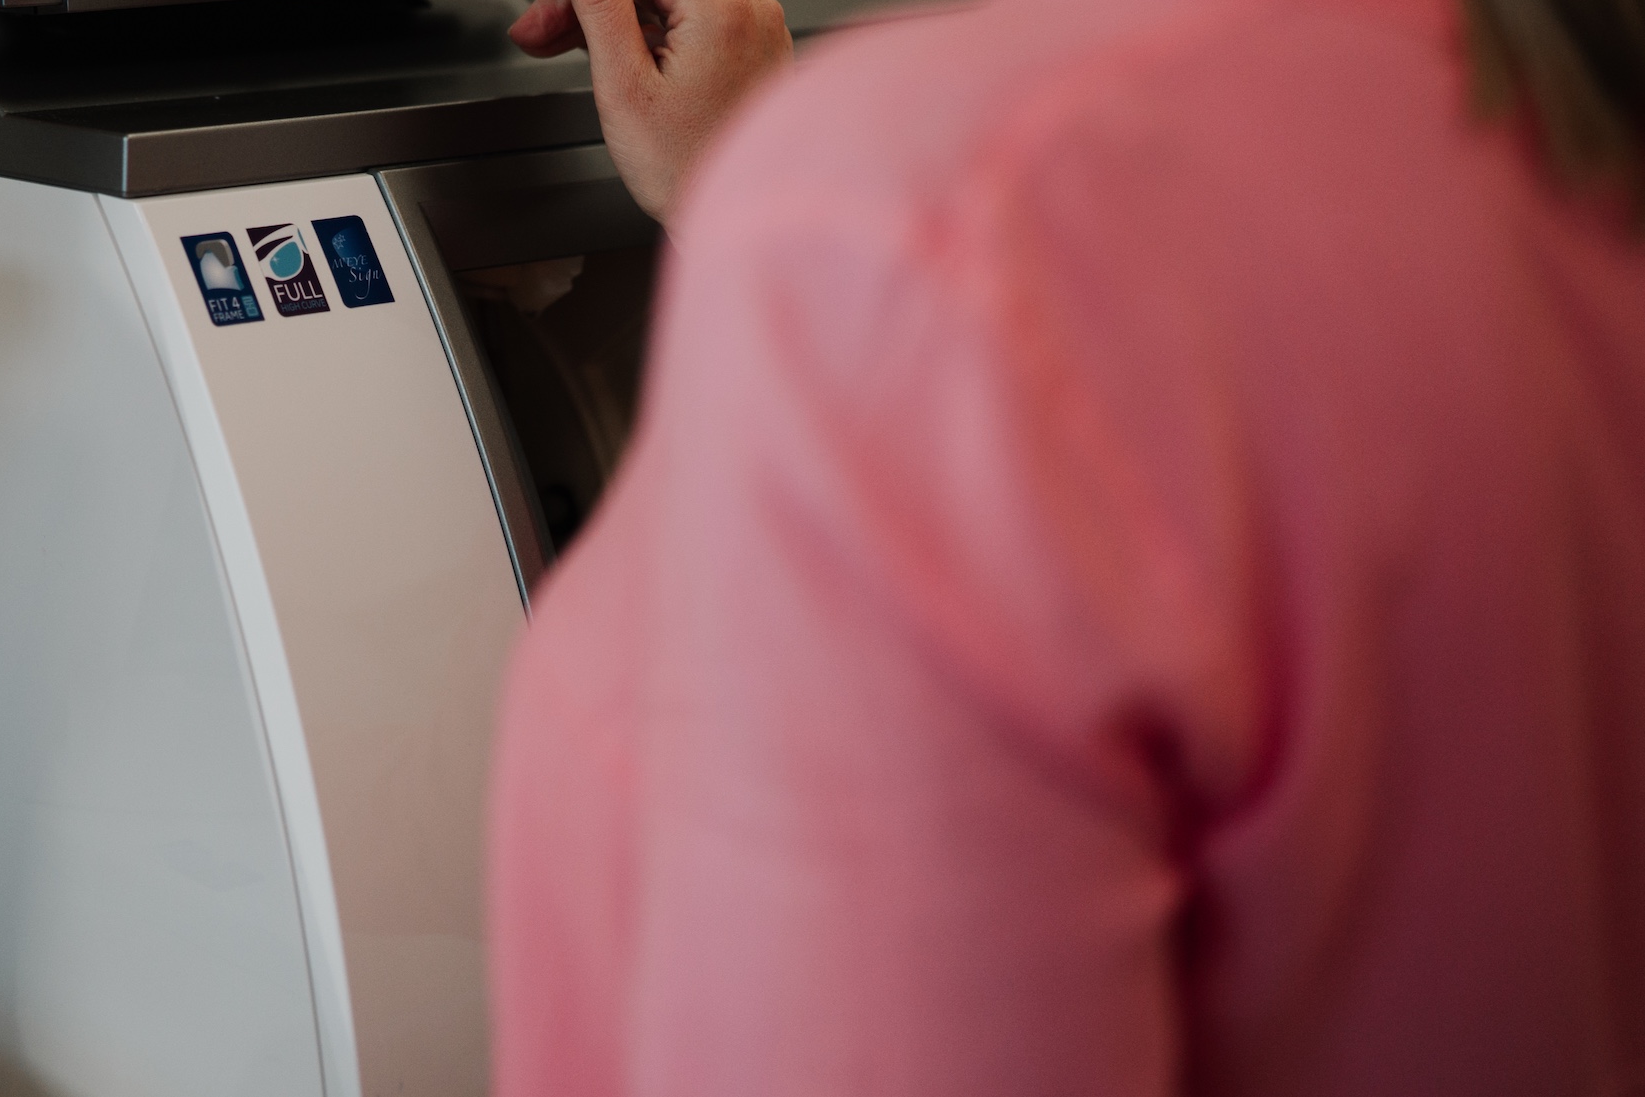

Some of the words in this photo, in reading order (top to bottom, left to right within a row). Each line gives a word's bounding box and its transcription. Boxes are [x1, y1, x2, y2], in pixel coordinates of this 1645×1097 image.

[273, 280, 323, 303] FULL
[348, 266, 380, 300] Sign
[208, 298, 229, 313] FIT
[232, 296, 240, 310] 4
[280, 302, 301, 312] HIGH
[301, 298, 326, 310] CURVE
[213, 309, 245, 322] FRAME
